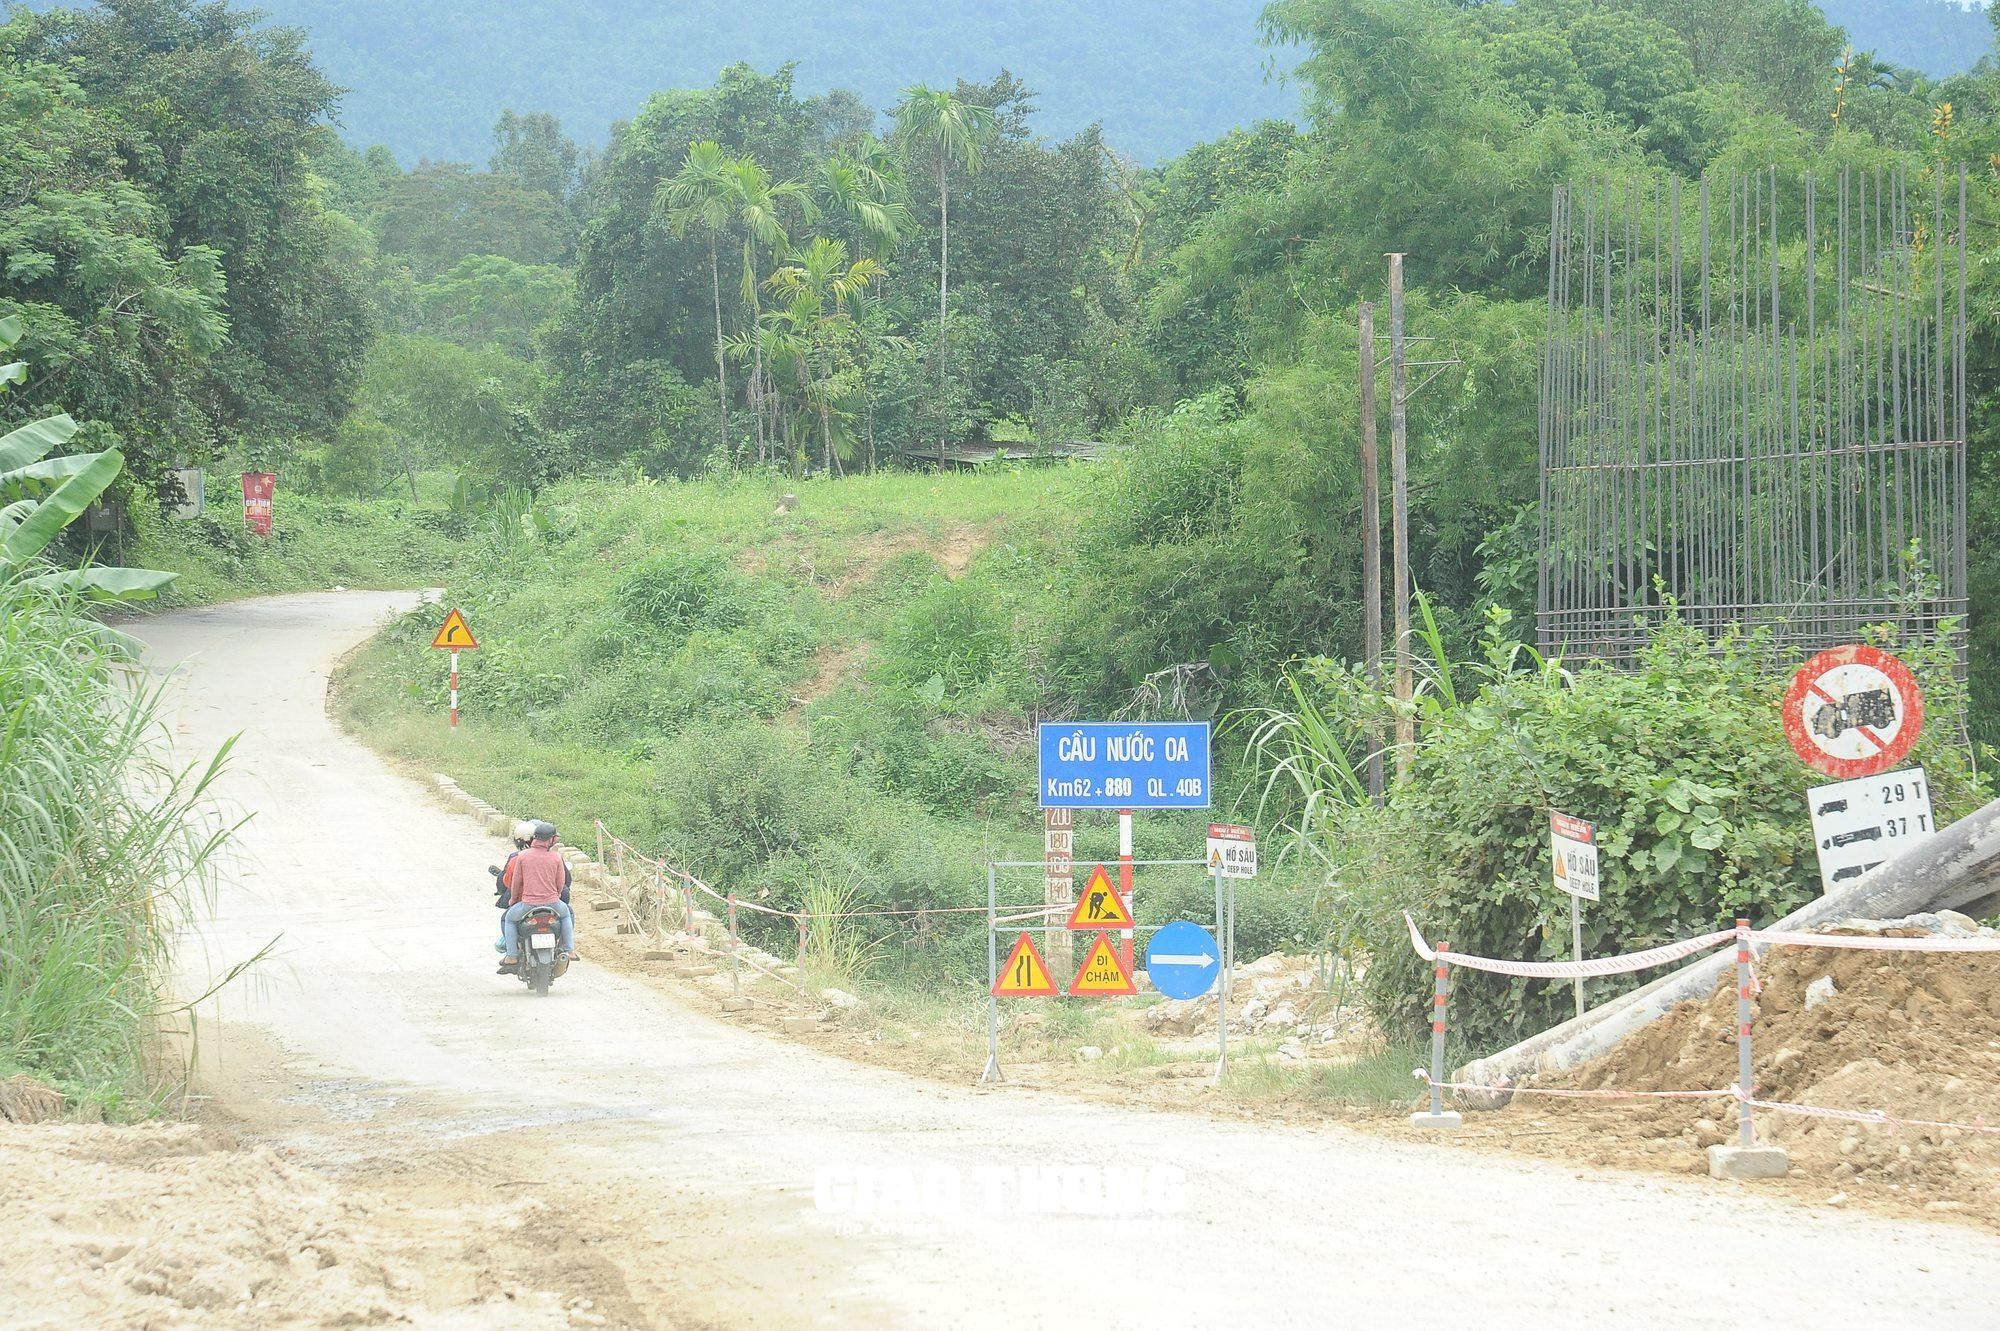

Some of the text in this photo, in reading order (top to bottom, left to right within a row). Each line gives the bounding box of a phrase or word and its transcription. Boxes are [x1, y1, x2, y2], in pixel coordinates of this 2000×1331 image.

[1058, 729, 1189, 762] CẦU NƯỚC OA
[1882, 781, 1921, 804] 29 T
[1886, 814, 1926, 838] 37 T
[1050, 832, 1068, 849] 180
[1226, 845, 1255, 863] HỐ SÂU
[1227, 865, 1253, 875] DEEP HOLE
[1579, 854, 1595, 877] SÂU
[1097, 955, 1108, 966] ĐI
[1086, 969, 1119, 984] CHẬM
